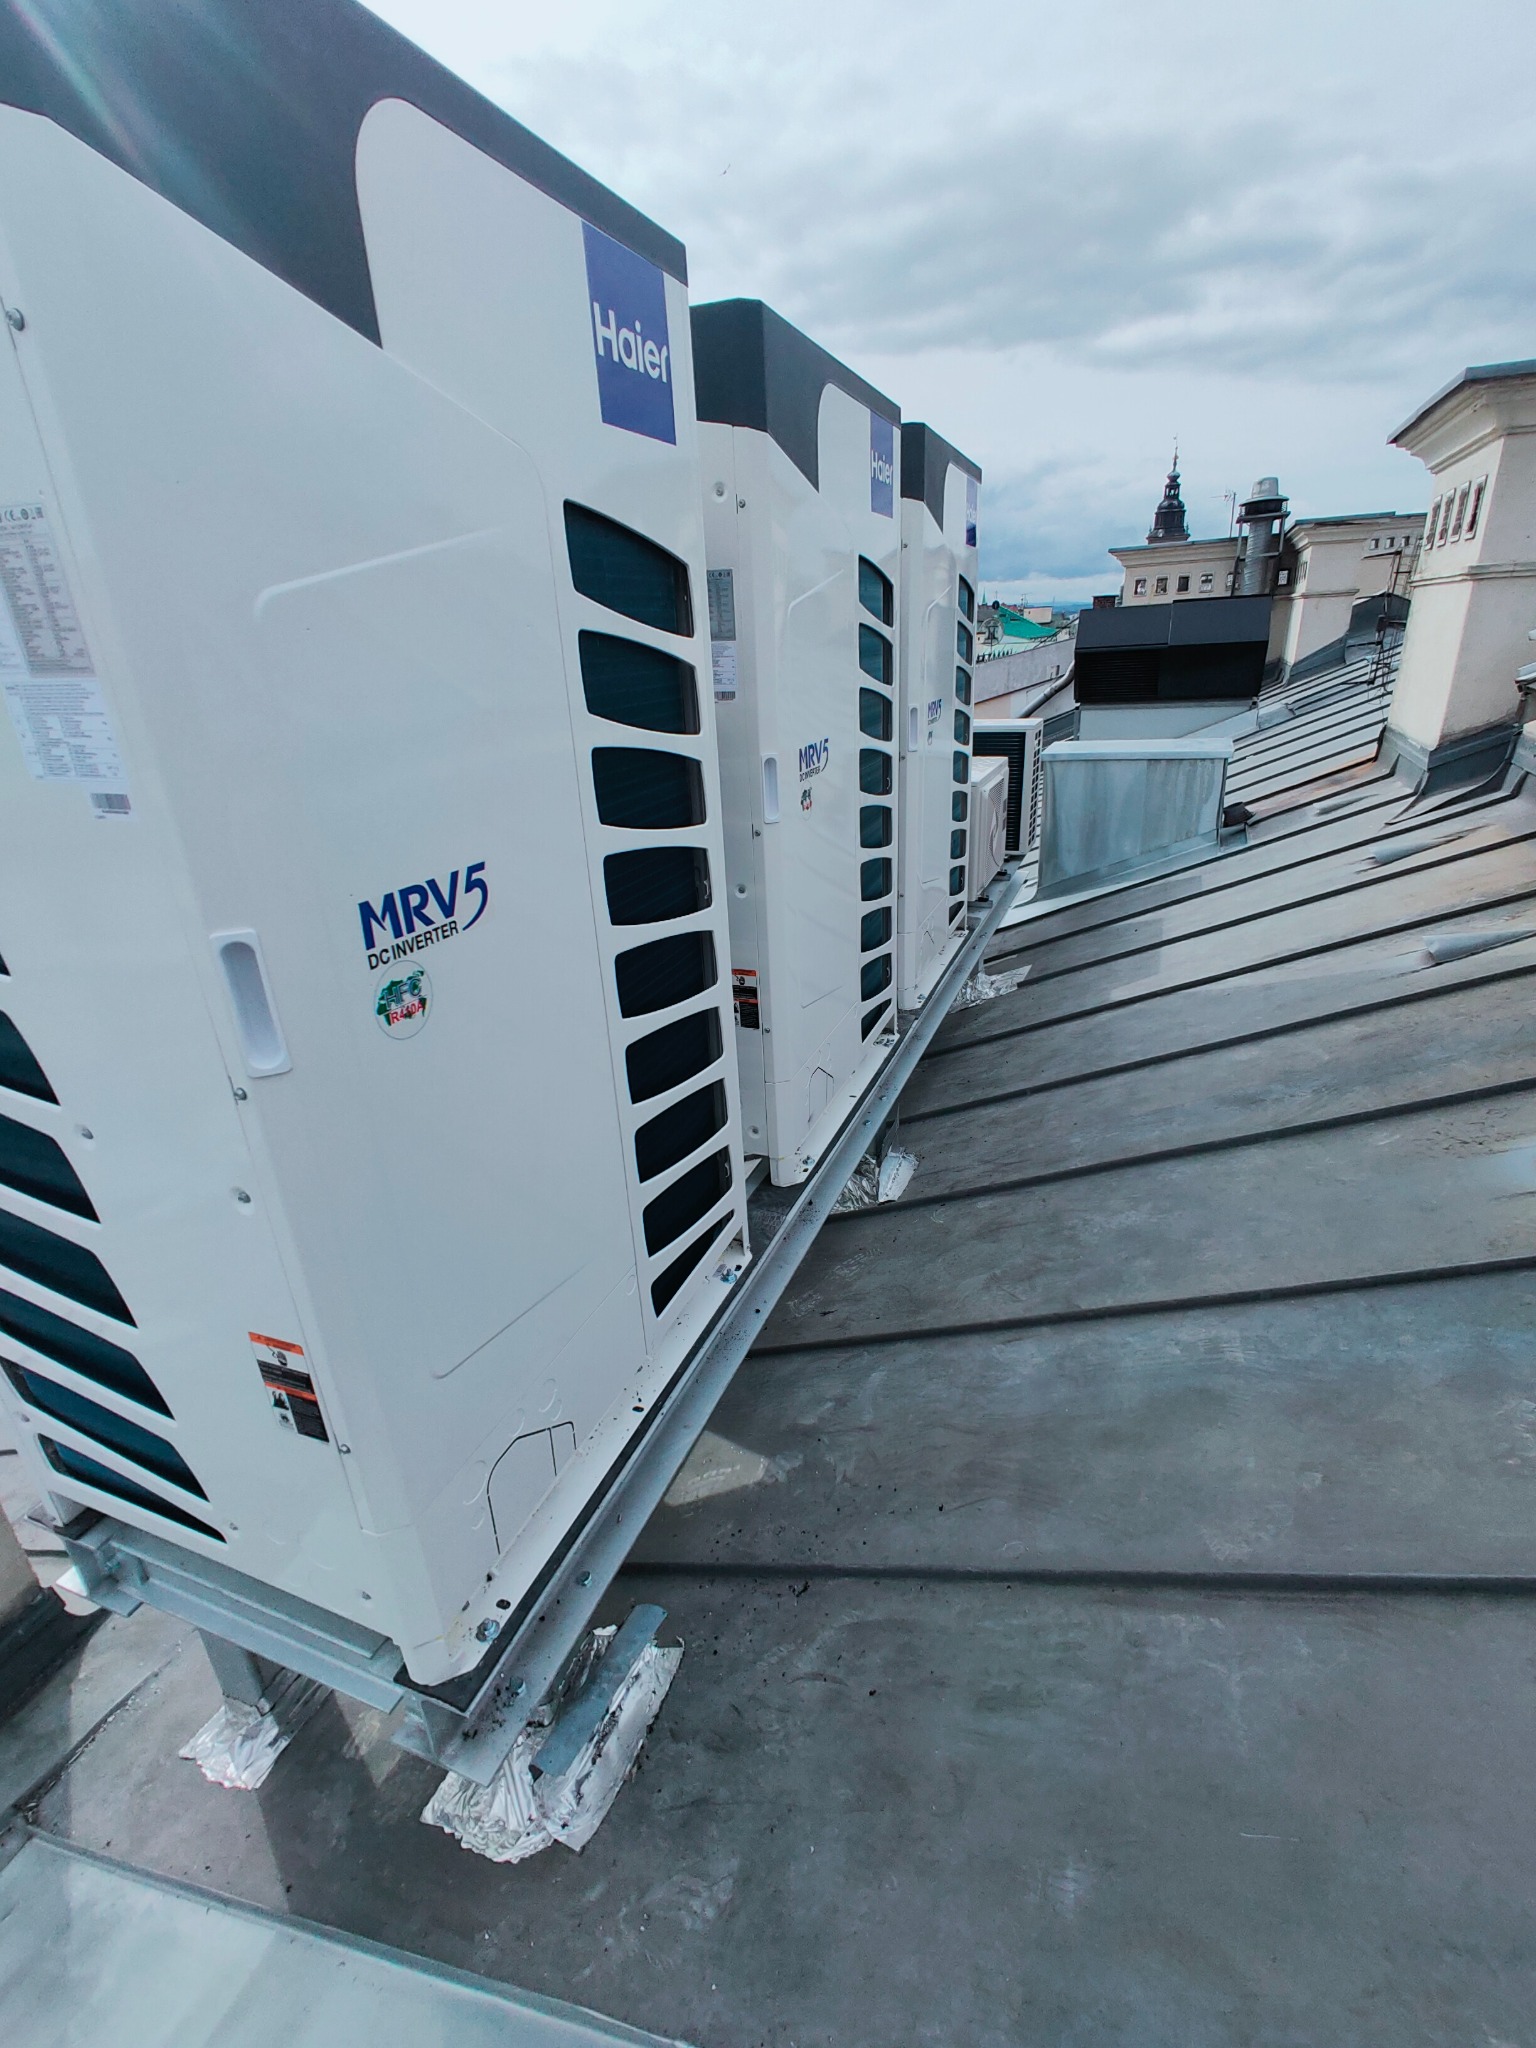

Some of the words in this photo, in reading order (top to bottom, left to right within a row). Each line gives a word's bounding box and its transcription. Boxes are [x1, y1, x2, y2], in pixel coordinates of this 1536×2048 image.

[592, 301, 669, 384] Haier
[871, 449, 893, 486] Haier
[799, 738, 829, 773] MRV5
[357, 861, 489, 951] MRV5
[367, 949, 391, 970] DC
[391, 920, 459, 960] INVERTER
[383, 977, 423, 1011] HFC
